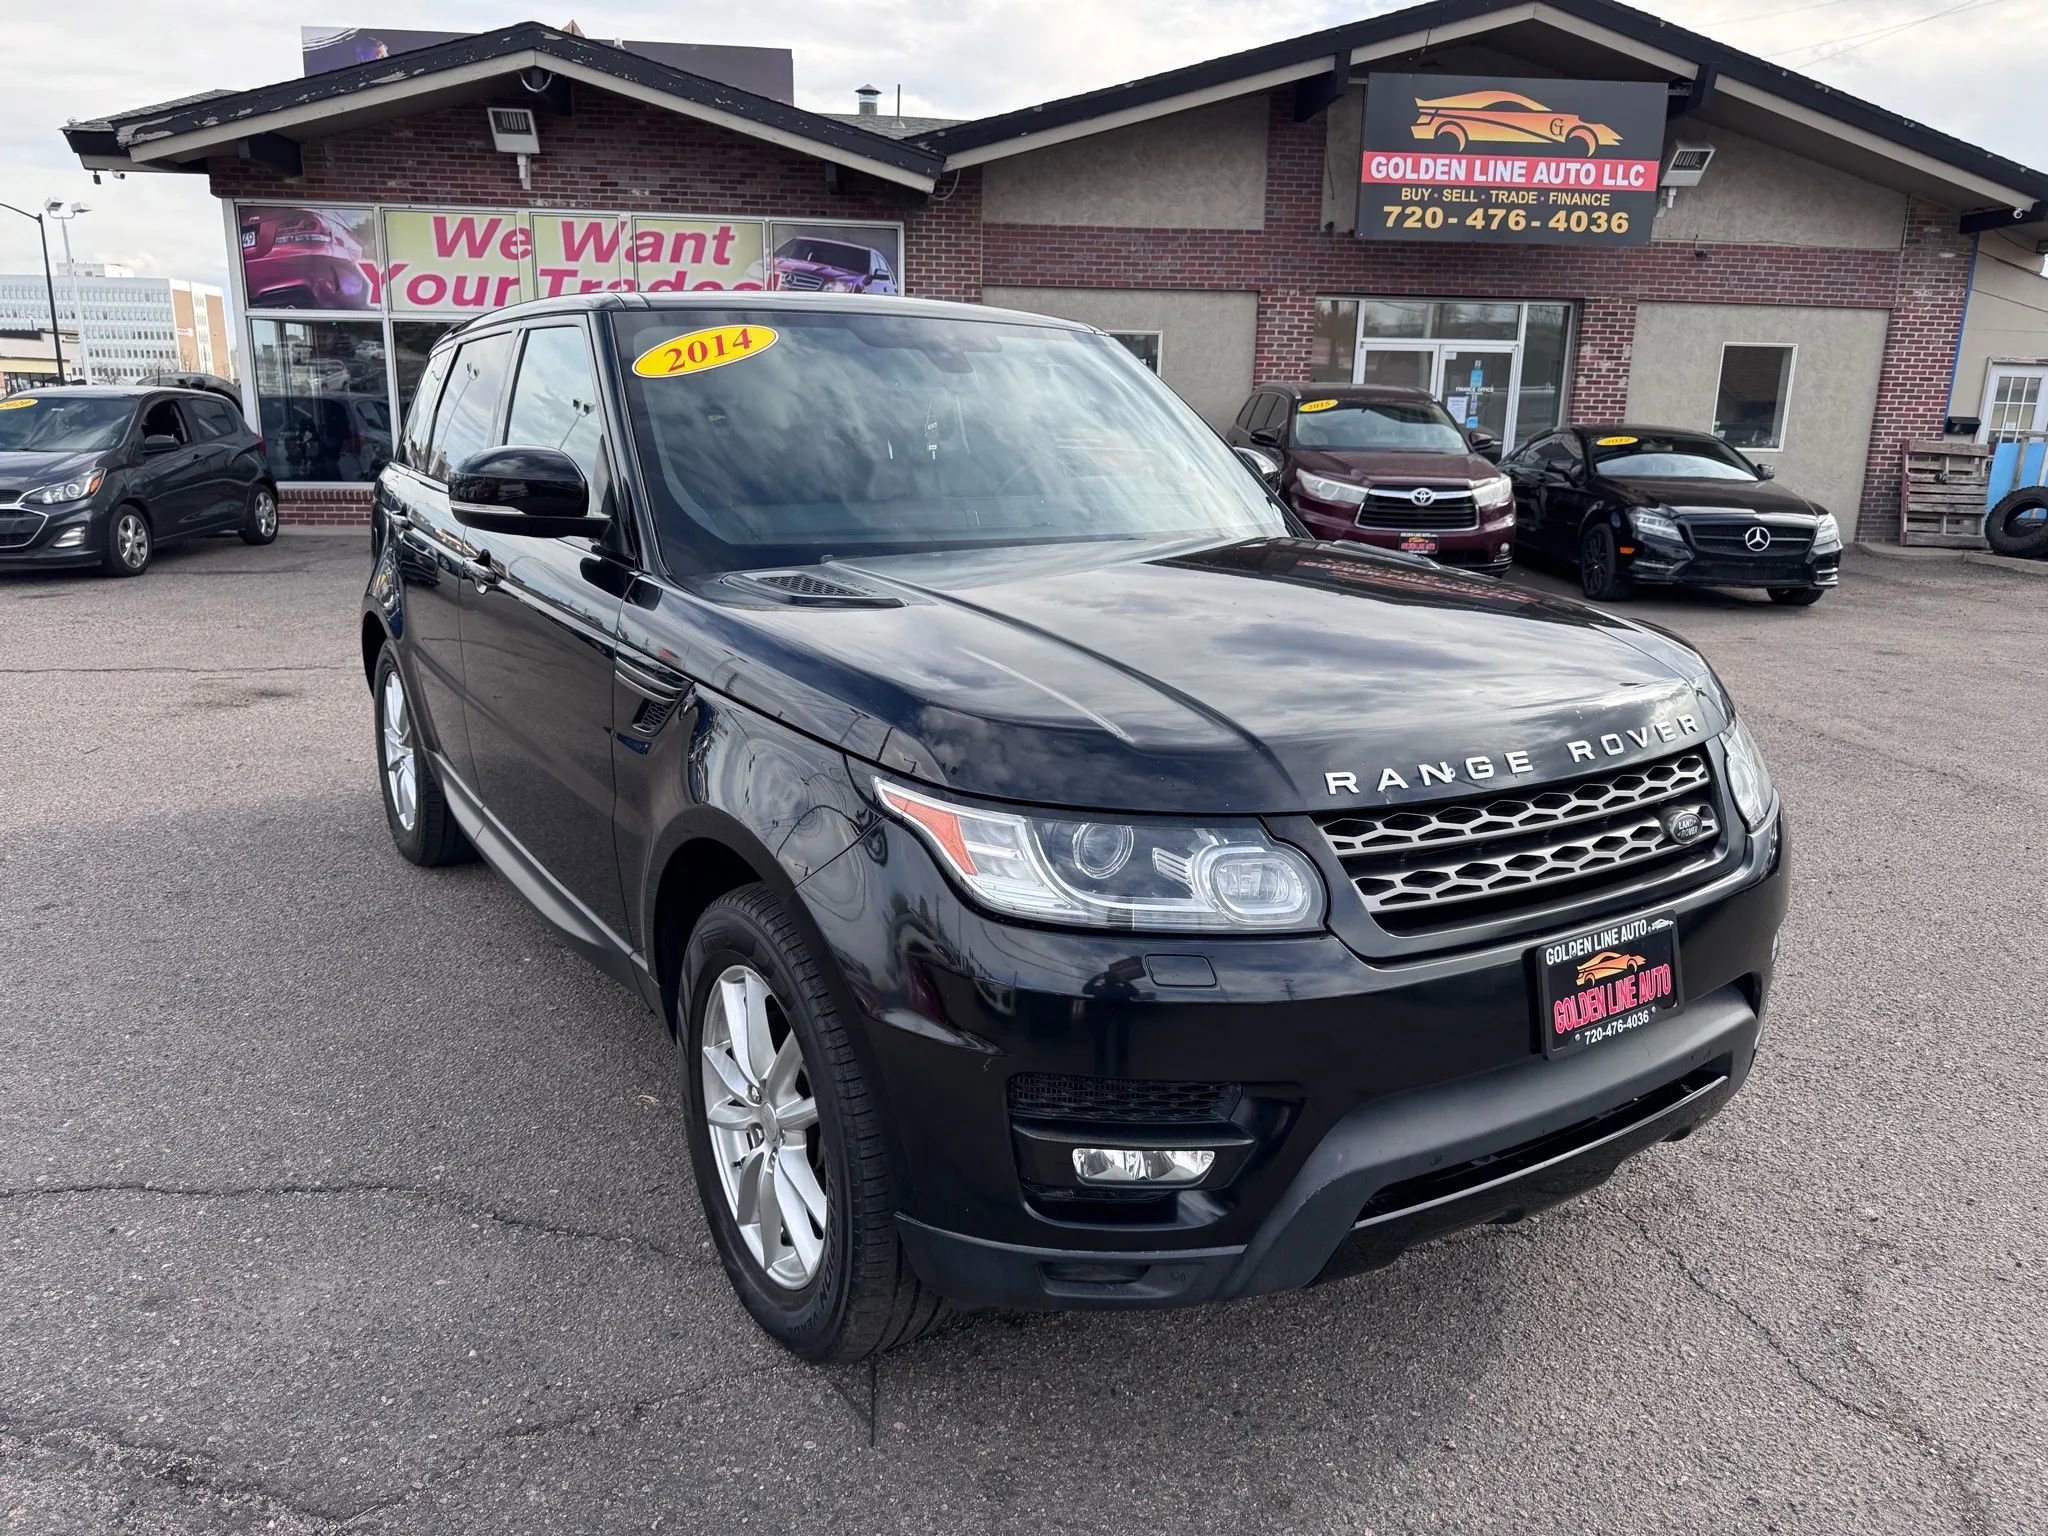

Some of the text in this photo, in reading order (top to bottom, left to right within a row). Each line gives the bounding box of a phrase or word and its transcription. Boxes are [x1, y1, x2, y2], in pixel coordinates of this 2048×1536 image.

[1550, 118, 1564, 137] G
[1370, 155, 1645, 187] GOLDEN LINE AUTO LLC
[1401, 187, 1611, 206] BUY SELL TRADE FINANCE
[432, 216, 736, 266] We Want
[358, 262, 521, 307] Your
[664, 328, 752, 372] 2014
[1323, 714, 1700, 796] RANGE ROVER
[1545, 919, 1647, 966] GOLDEN LINE AUTO
[1553, 963, 1672, 1034] GOLDEN LINE AUTO
[1584, 1009, 1650, 1045] 720-476-4036
